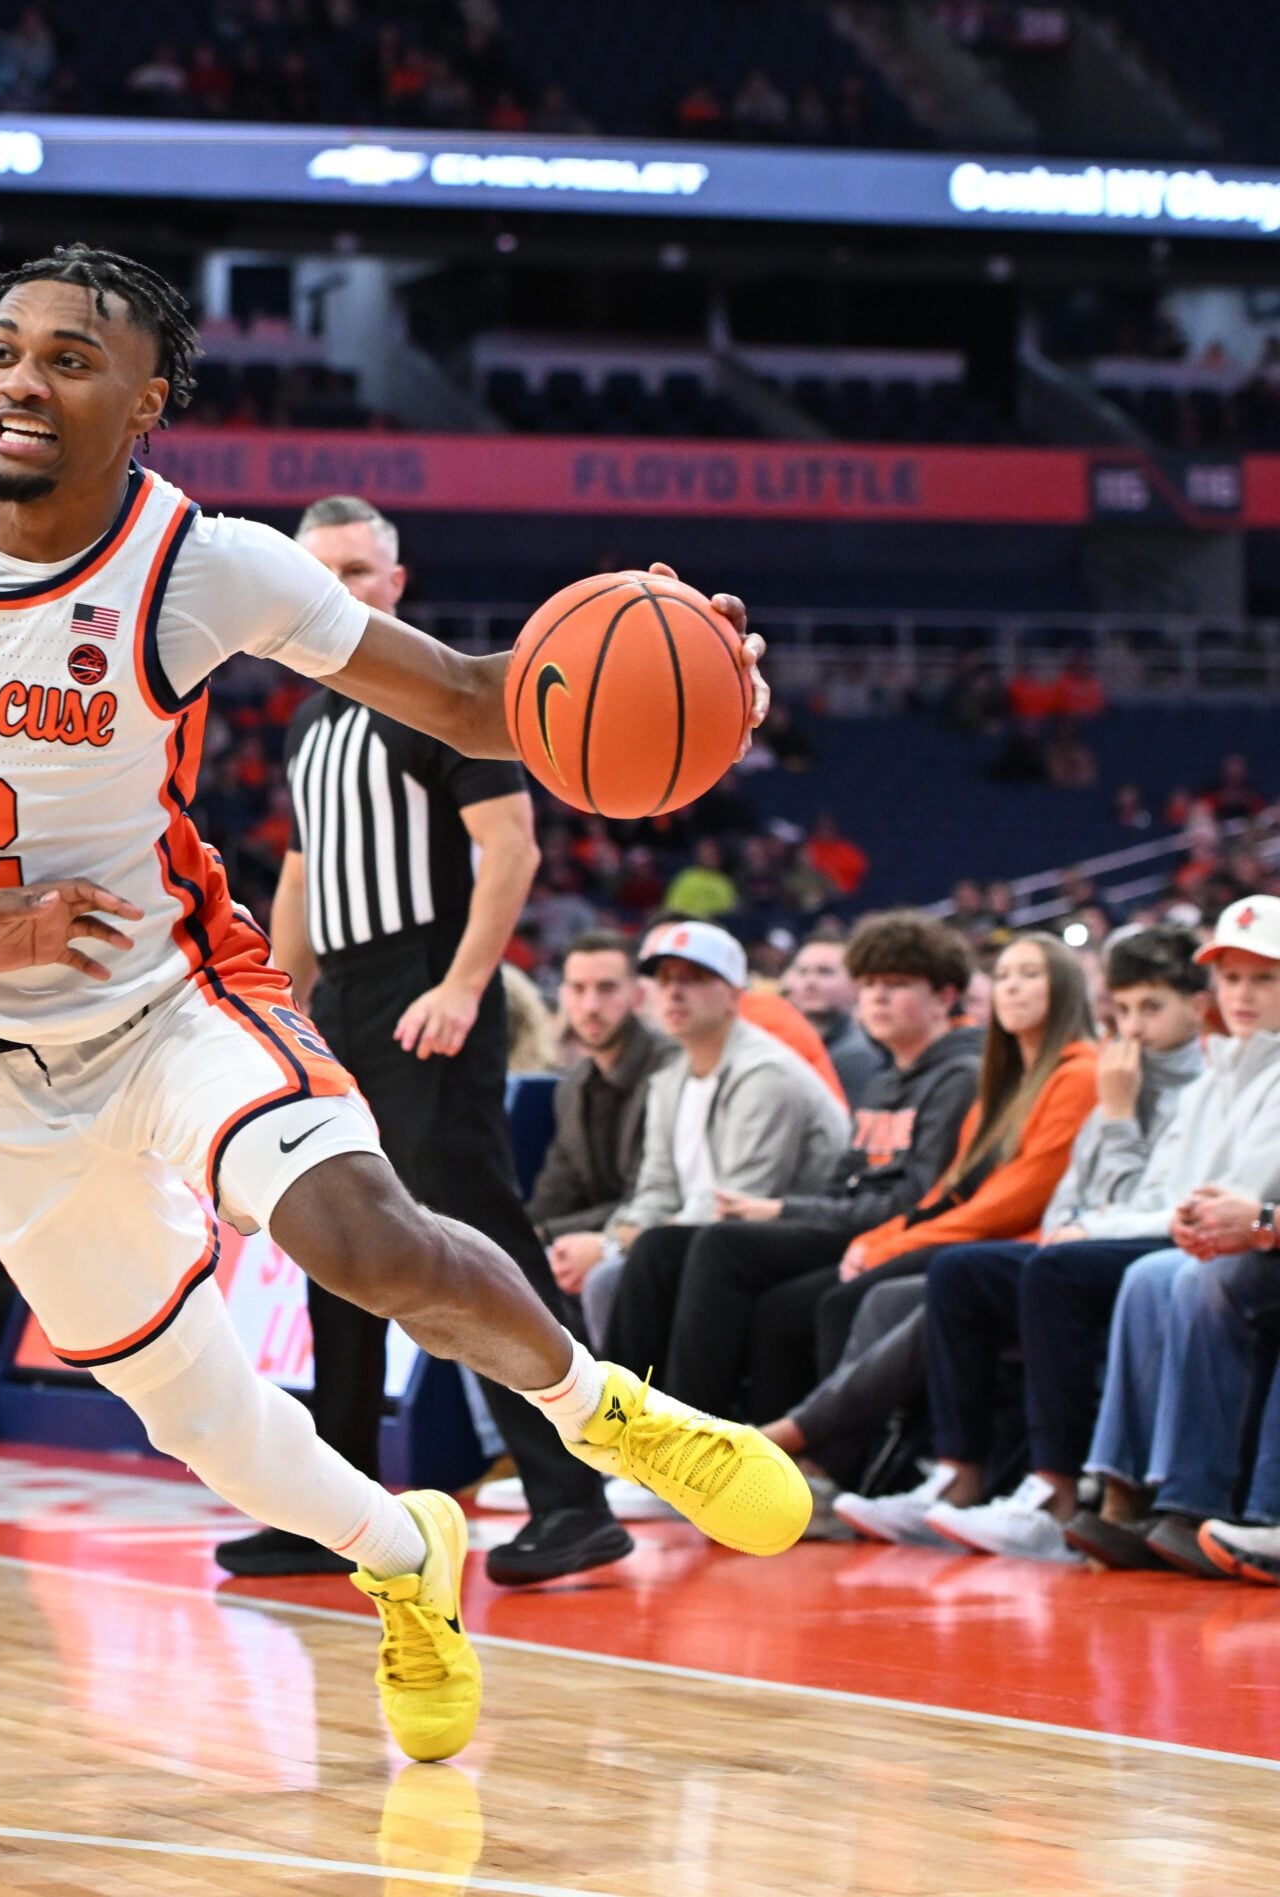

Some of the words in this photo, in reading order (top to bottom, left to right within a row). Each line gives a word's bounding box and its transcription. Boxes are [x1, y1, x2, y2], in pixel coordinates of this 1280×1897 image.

[431, 153, 709, 194] CHEVROLET
[950, 163, 1103, 216] Central
[1105, 169, 1165, 218] NY
[268, 444, 426, 494] DAVIS
[573, 451, 739, 501] FLOYD
[751, 456, 920, 507] LITTLE
